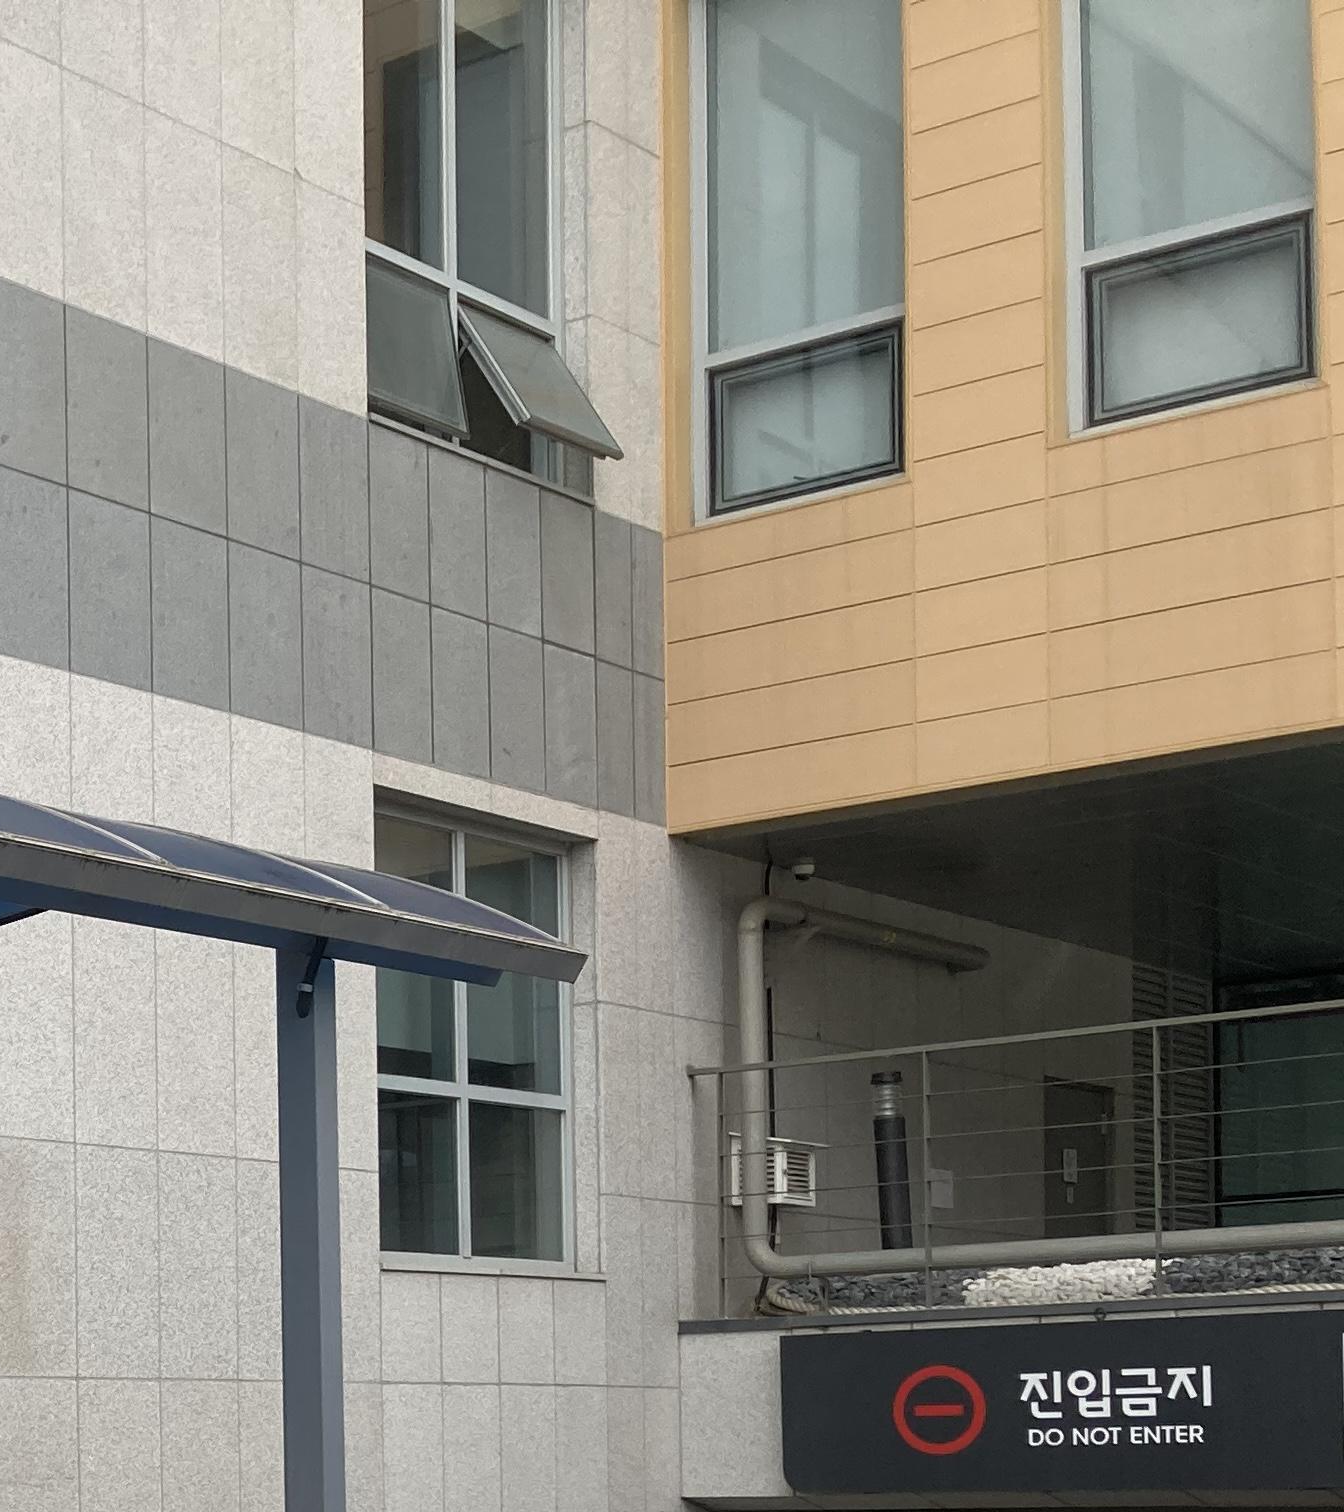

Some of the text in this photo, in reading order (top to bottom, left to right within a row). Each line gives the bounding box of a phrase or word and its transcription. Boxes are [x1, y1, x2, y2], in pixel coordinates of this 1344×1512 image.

[1019, 1365, 1212, 1420] 진입금지
[1027, 1424, 1205, 1447] DO NOT ENTER
